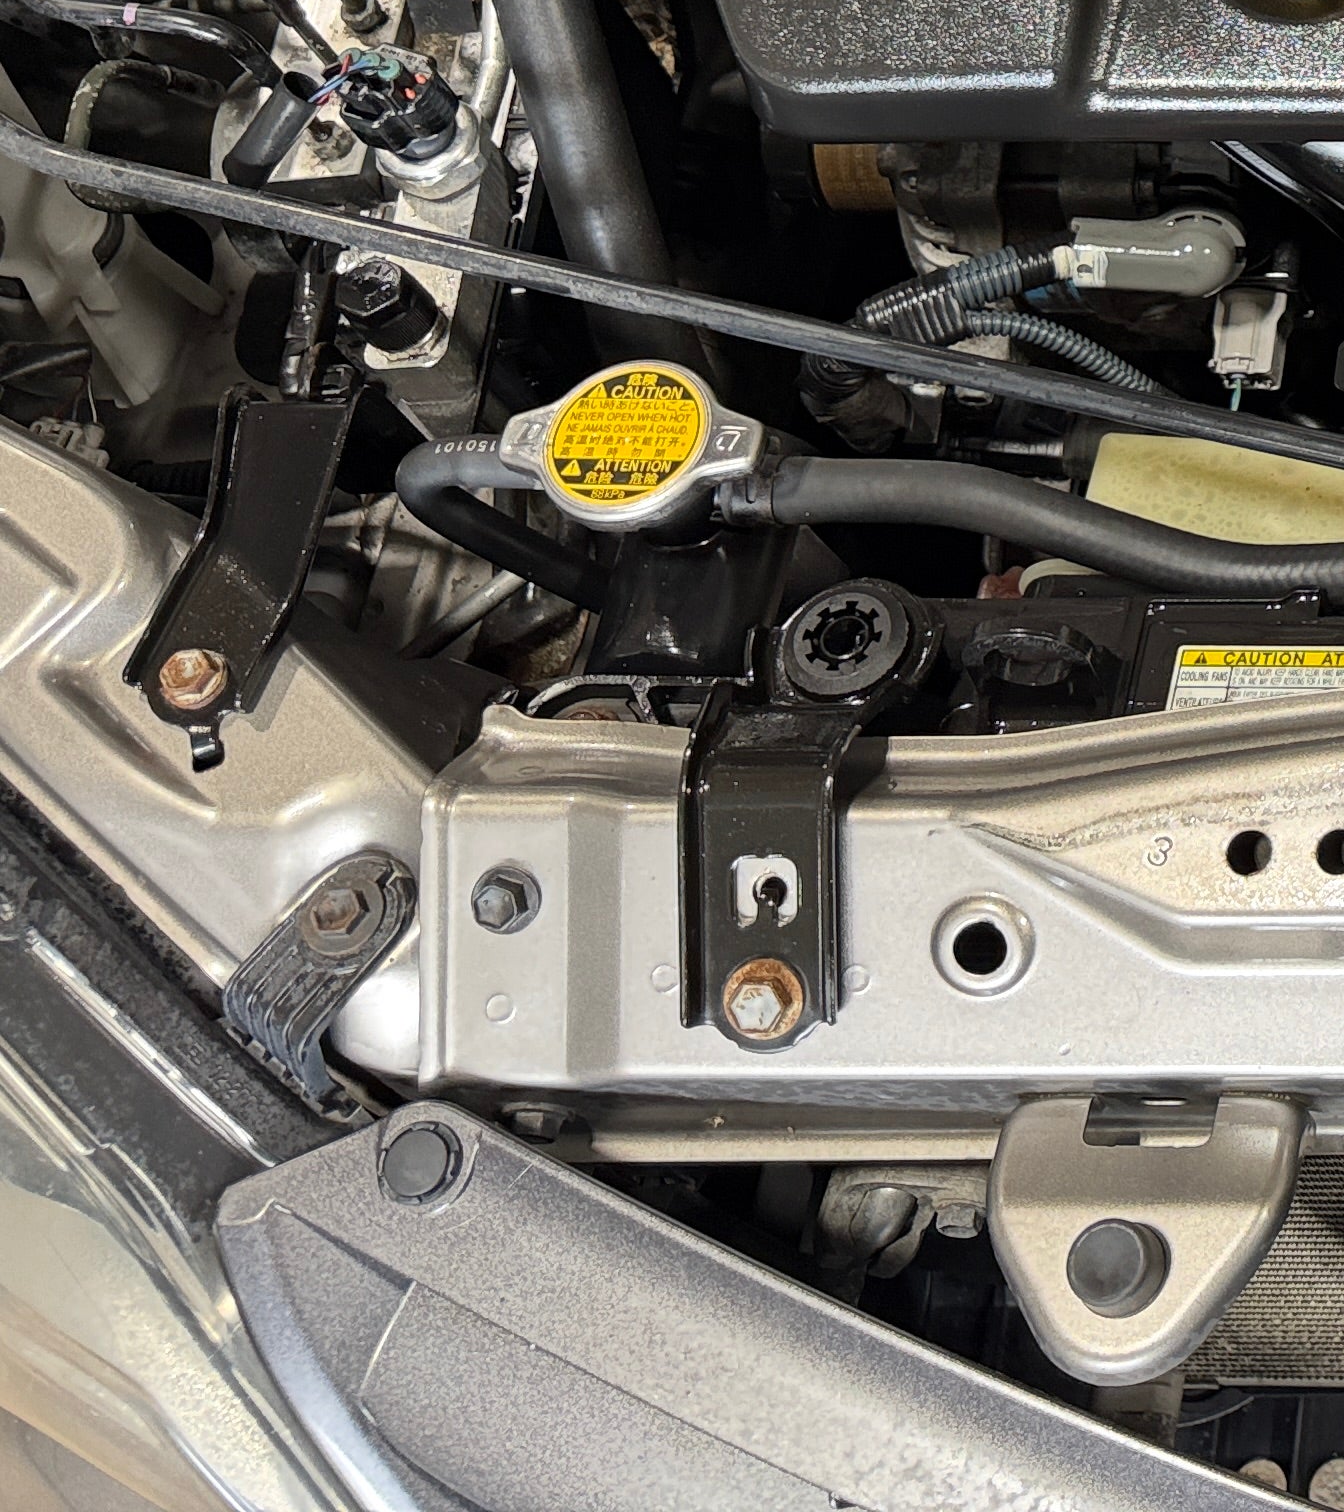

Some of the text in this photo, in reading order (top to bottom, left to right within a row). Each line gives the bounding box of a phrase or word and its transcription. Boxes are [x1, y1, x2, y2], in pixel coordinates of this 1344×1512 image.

[611, 385, 684, 400] CAUTION
[570, 412, 692, 423] NEVER OPEN WHEN HOT
[566, 424, 579, 433] NE
[580, 424, 611, 433] JAMAIS
[613, 424, 647, 434] OUVRIR
[594, 459, 672, 473] ATTENTION
[1223, 652, 1306, 666] CAUTION
[1180, 671, 1229, 682] COOLING FANS
[1147, 835, 1174, 868] 3
